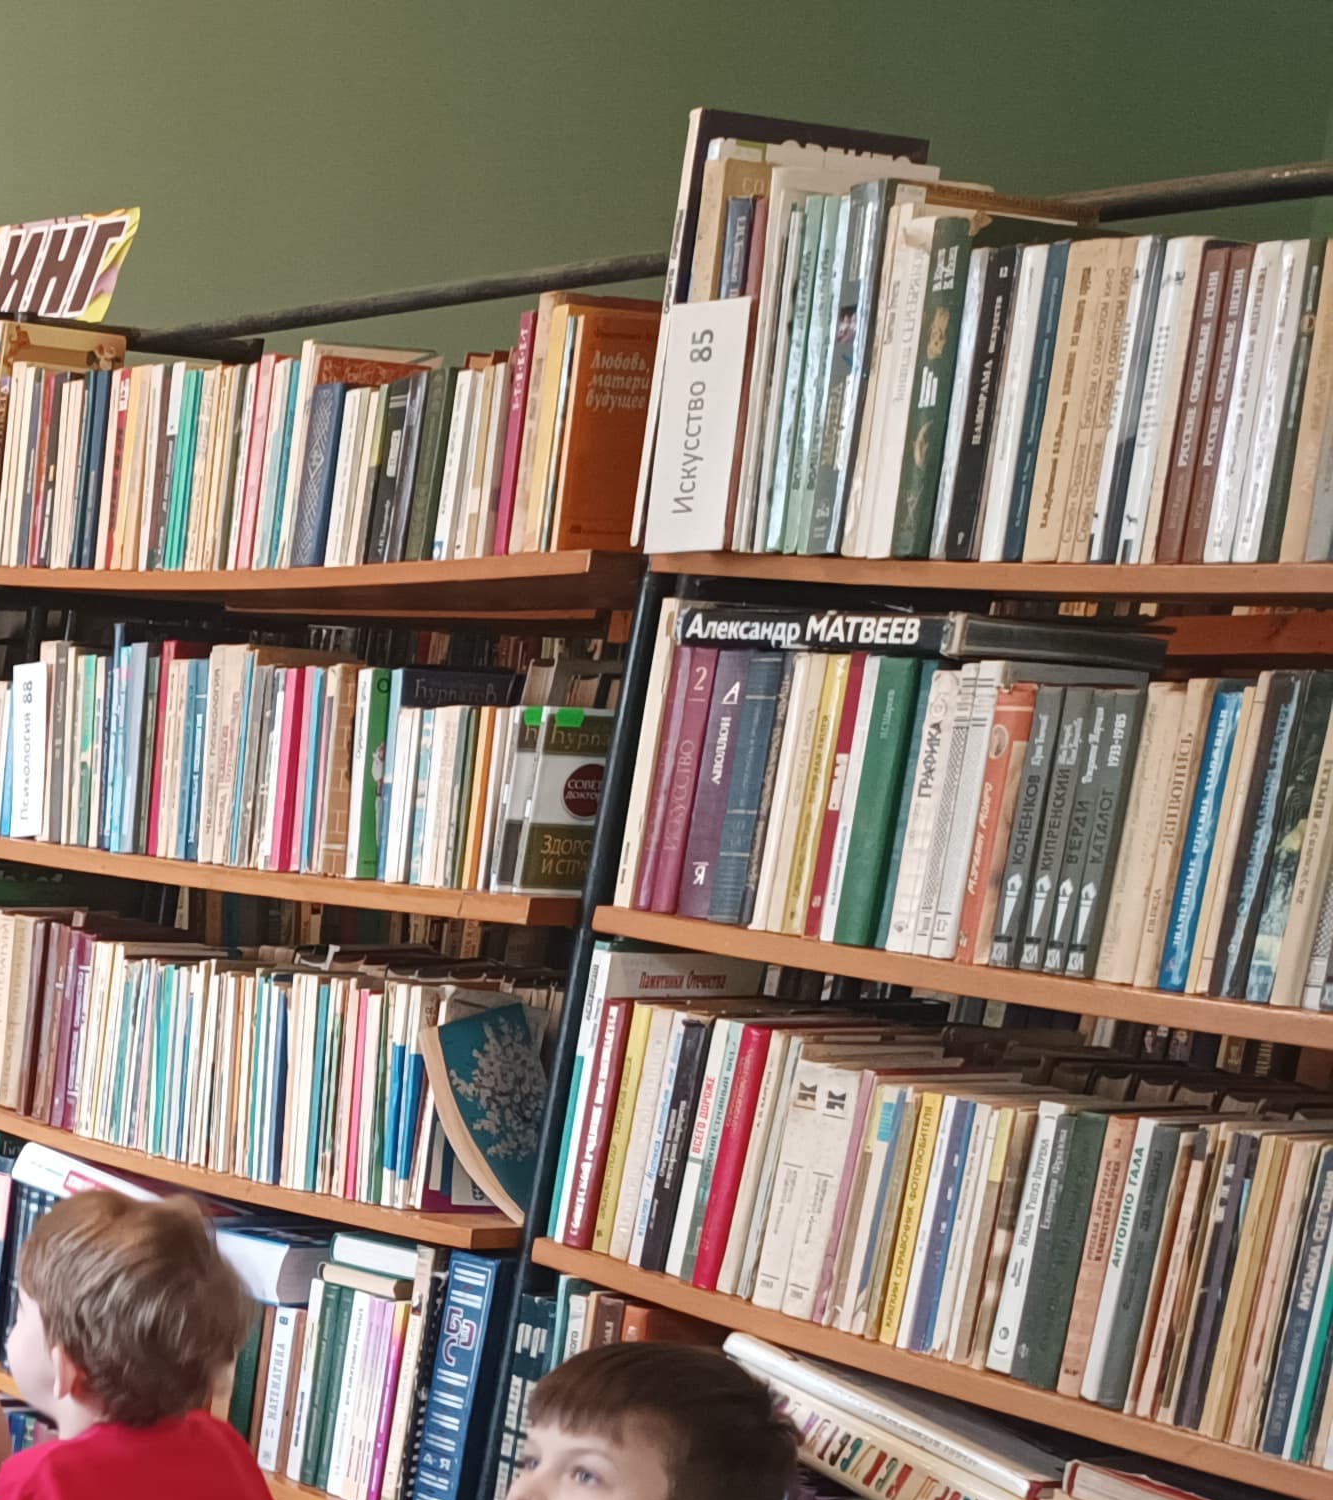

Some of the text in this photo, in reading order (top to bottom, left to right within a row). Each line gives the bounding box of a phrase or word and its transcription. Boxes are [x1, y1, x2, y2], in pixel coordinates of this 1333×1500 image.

[590, 350, 651, 374] Любовь,
[971, 357, 993, 446] ПАНОРАМА
[672, 328, 715, 515] Искусство 85
[686, 613, 921, 648] Александр МАТВЕЕВ
[22, 680, 33, 703] 88
[691, 665, 709, 691] 2
[19, 711, 32, 822] Психология
[663, 738, 695, 852] ИСКУССТВО
[916, 720, 943, 799] ГРАФИКА
[1011, 774, 1041, 866] КОНЕНКОВ
[1039, 766, 1072, 872] КИПРЕНСКИЙ
[1065, 801, 1090, 865] ВЕРДИ
[1089, 788, 1115, 865] КАТАЛОГ
[691, 1076, 717, 1155] ВСЕГО ДОРОЖЕ
[909, 1105, 934, 1203] ФОТОЛЮБИТЕЛЯ
[1111, 1146, 1145, 1269] АНТОНИО ГАЛА
[1296, 1236, 1323, 1312] МУЗЫКА
[266, 1341, 287, 1430] МАТЕМАТИКА
